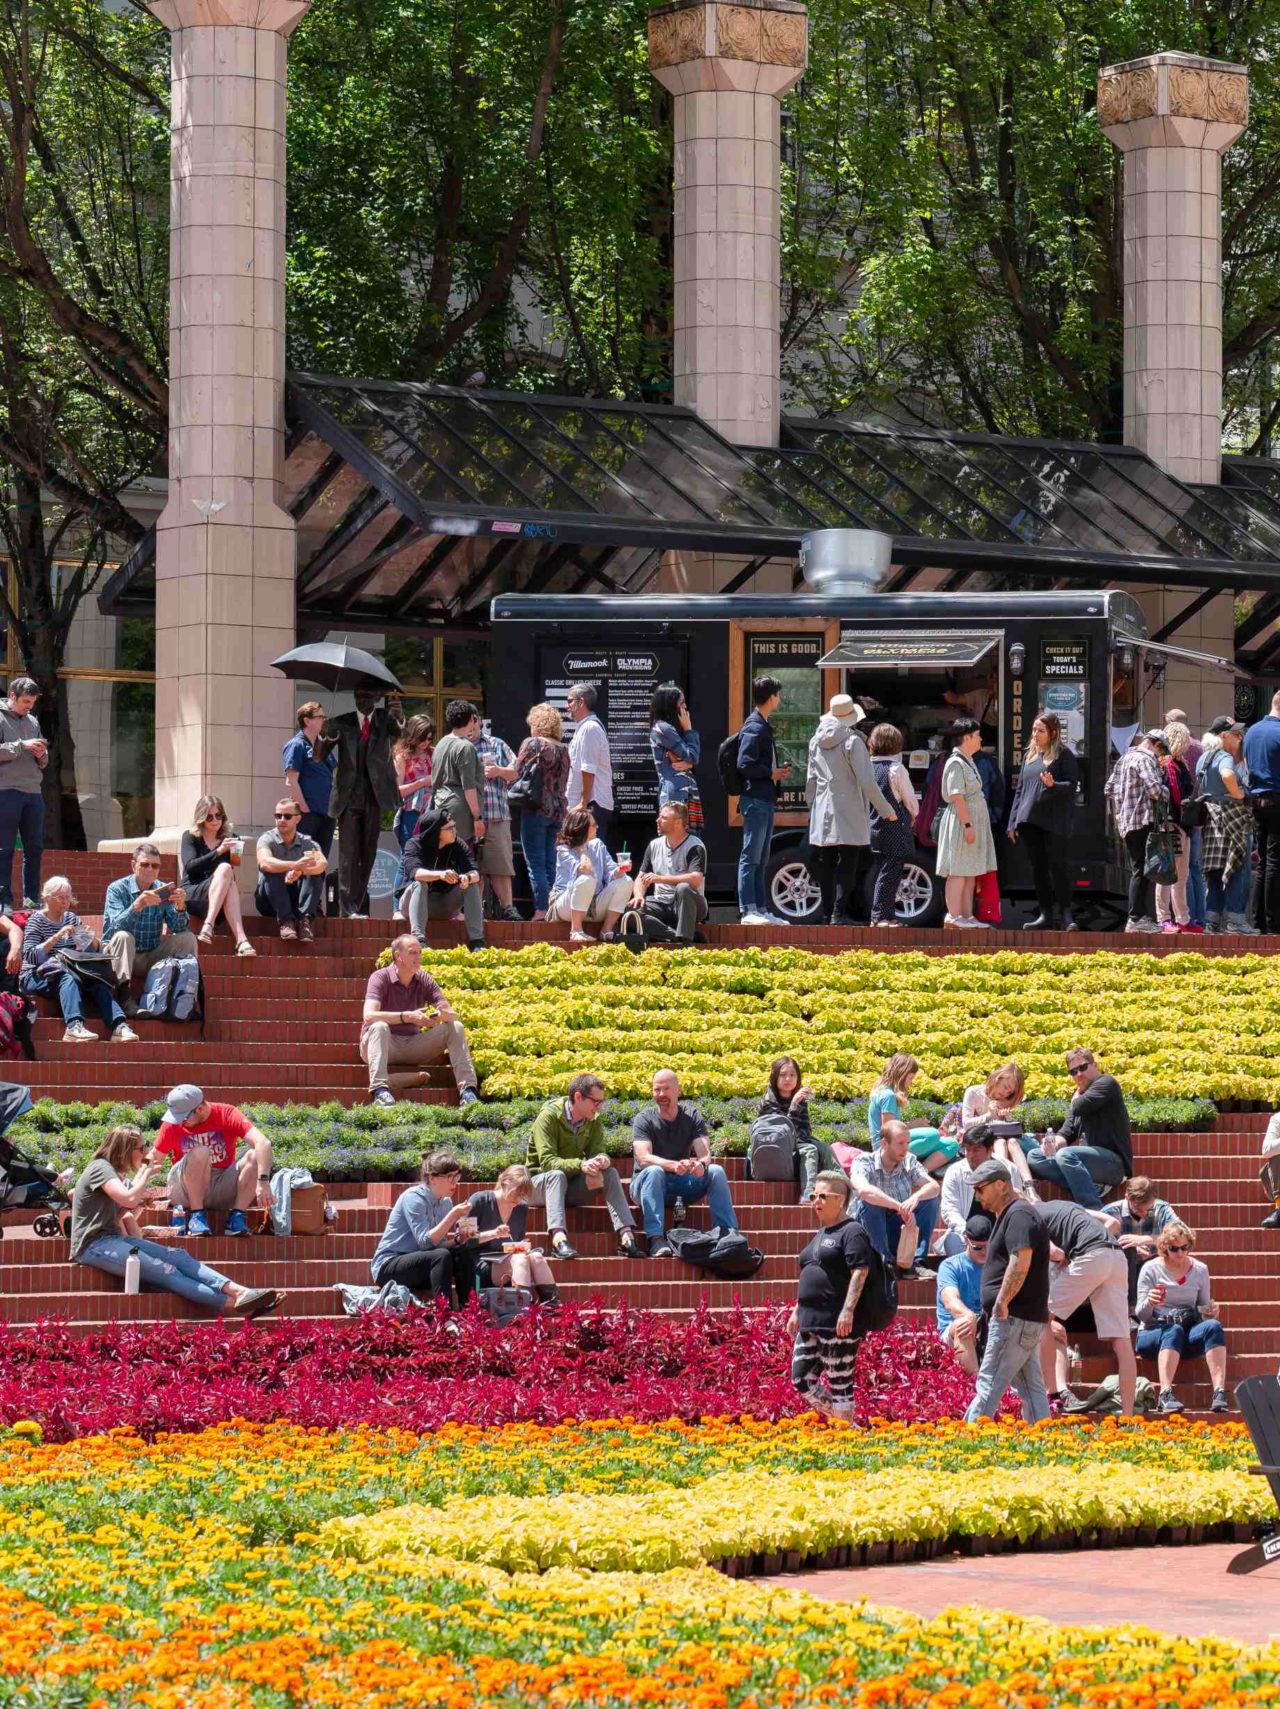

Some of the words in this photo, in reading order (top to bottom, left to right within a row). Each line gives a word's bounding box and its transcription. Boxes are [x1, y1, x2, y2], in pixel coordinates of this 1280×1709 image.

[754, 643, 775, 653] THIS
[778, 643, 788, 653] IS
[792, 643, 820, 653] GOOD.
[568, 659, 608, 669] Tillamook
[617, 658, 653, 666] OLYMPIA
[1046, 665, 1084, 674] SPECIALS
[1012, 680, 1023, 766] ORDER
[613, 772, 625, 780] DES
